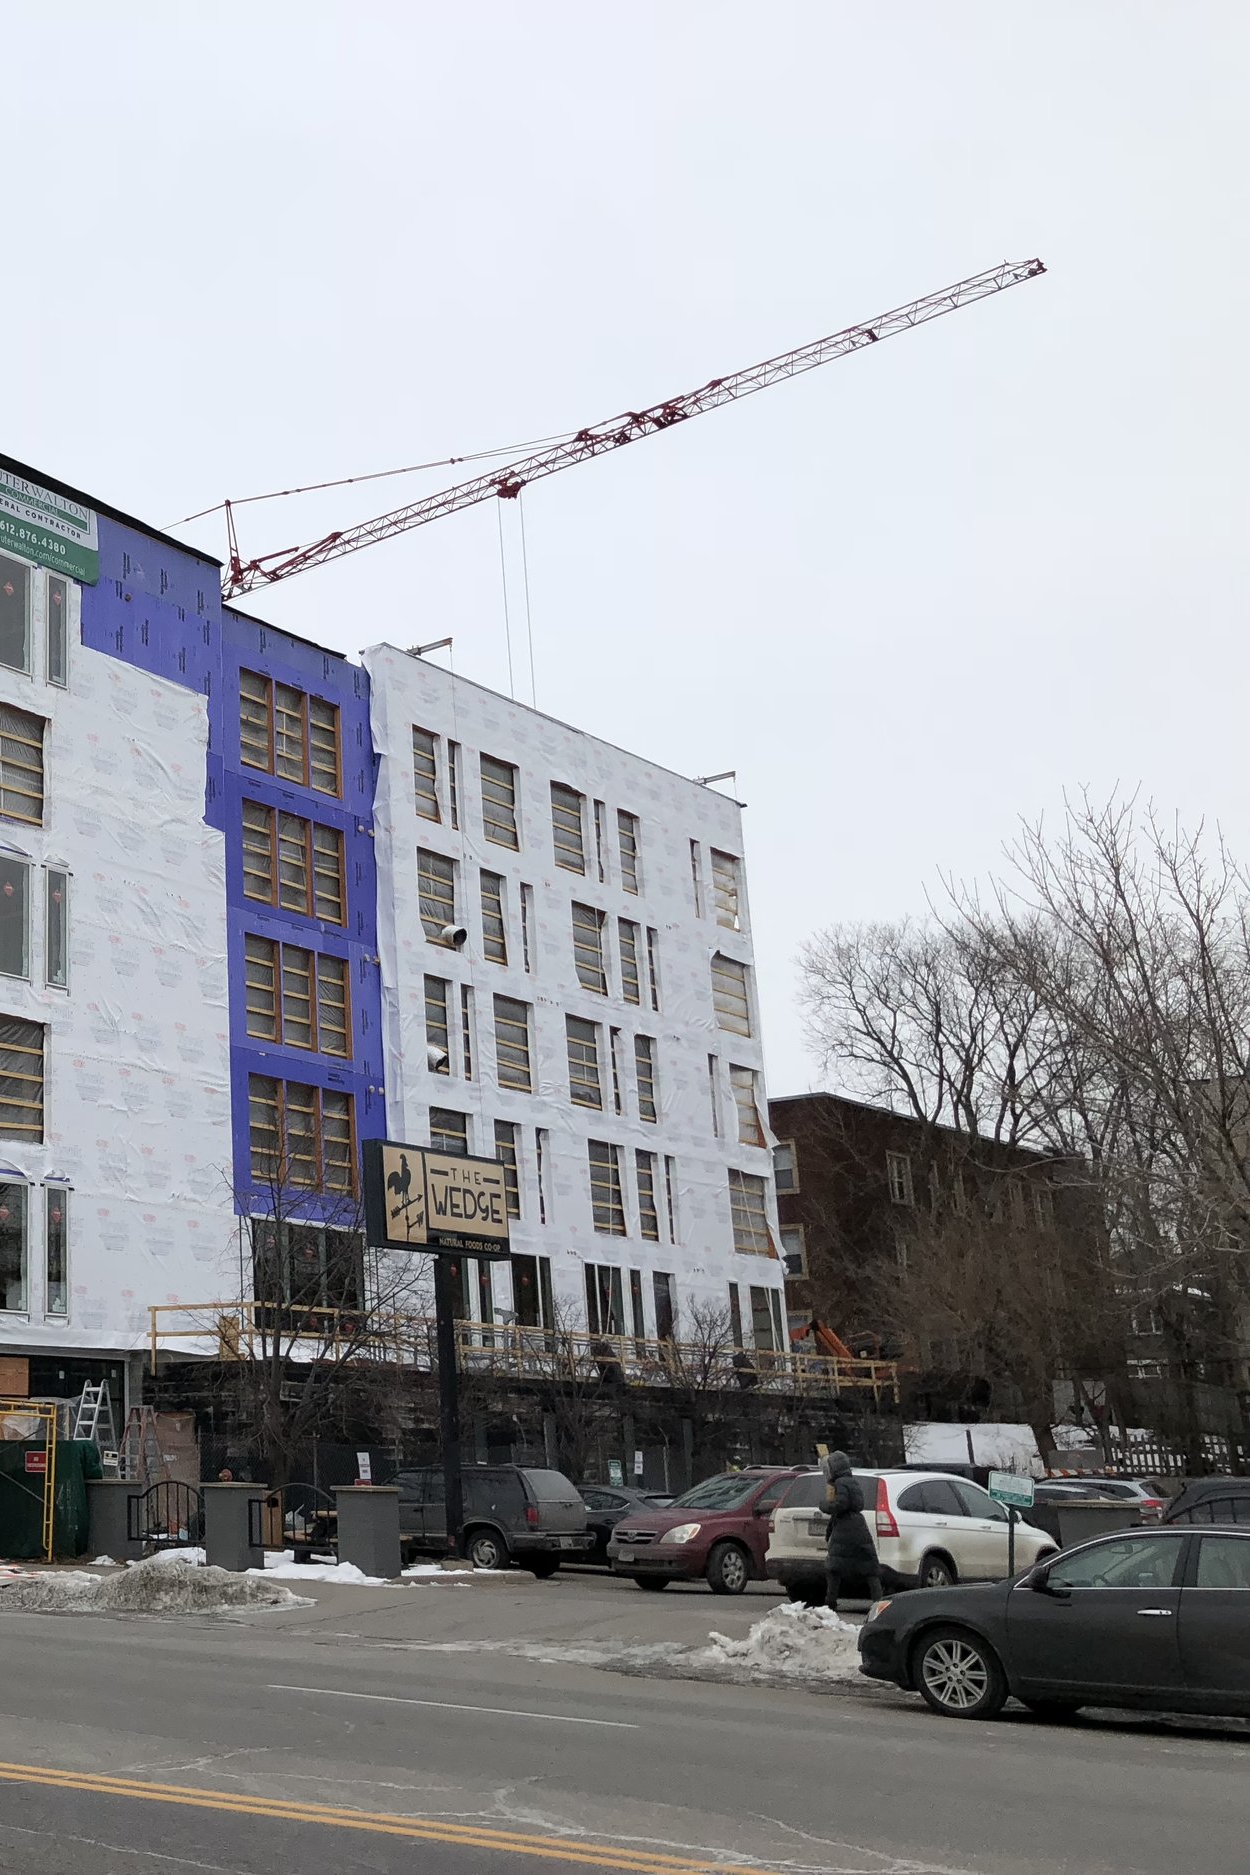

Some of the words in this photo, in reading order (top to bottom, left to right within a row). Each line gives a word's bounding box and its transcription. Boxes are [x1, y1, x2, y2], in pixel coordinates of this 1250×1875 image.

[5, 487, 60, 517] COMMERCIAL
[0, 520, 67, 556] 612.876.4380
[25, 509, 82, 540] CONTRACTOR
[450, 1167, 482, 1186] THE
[431, 1183, 504, 1224] WEDGE
[439, 1237, 464, 1248] NATURAL
[465, 1240, 484, 1250] FOODS
